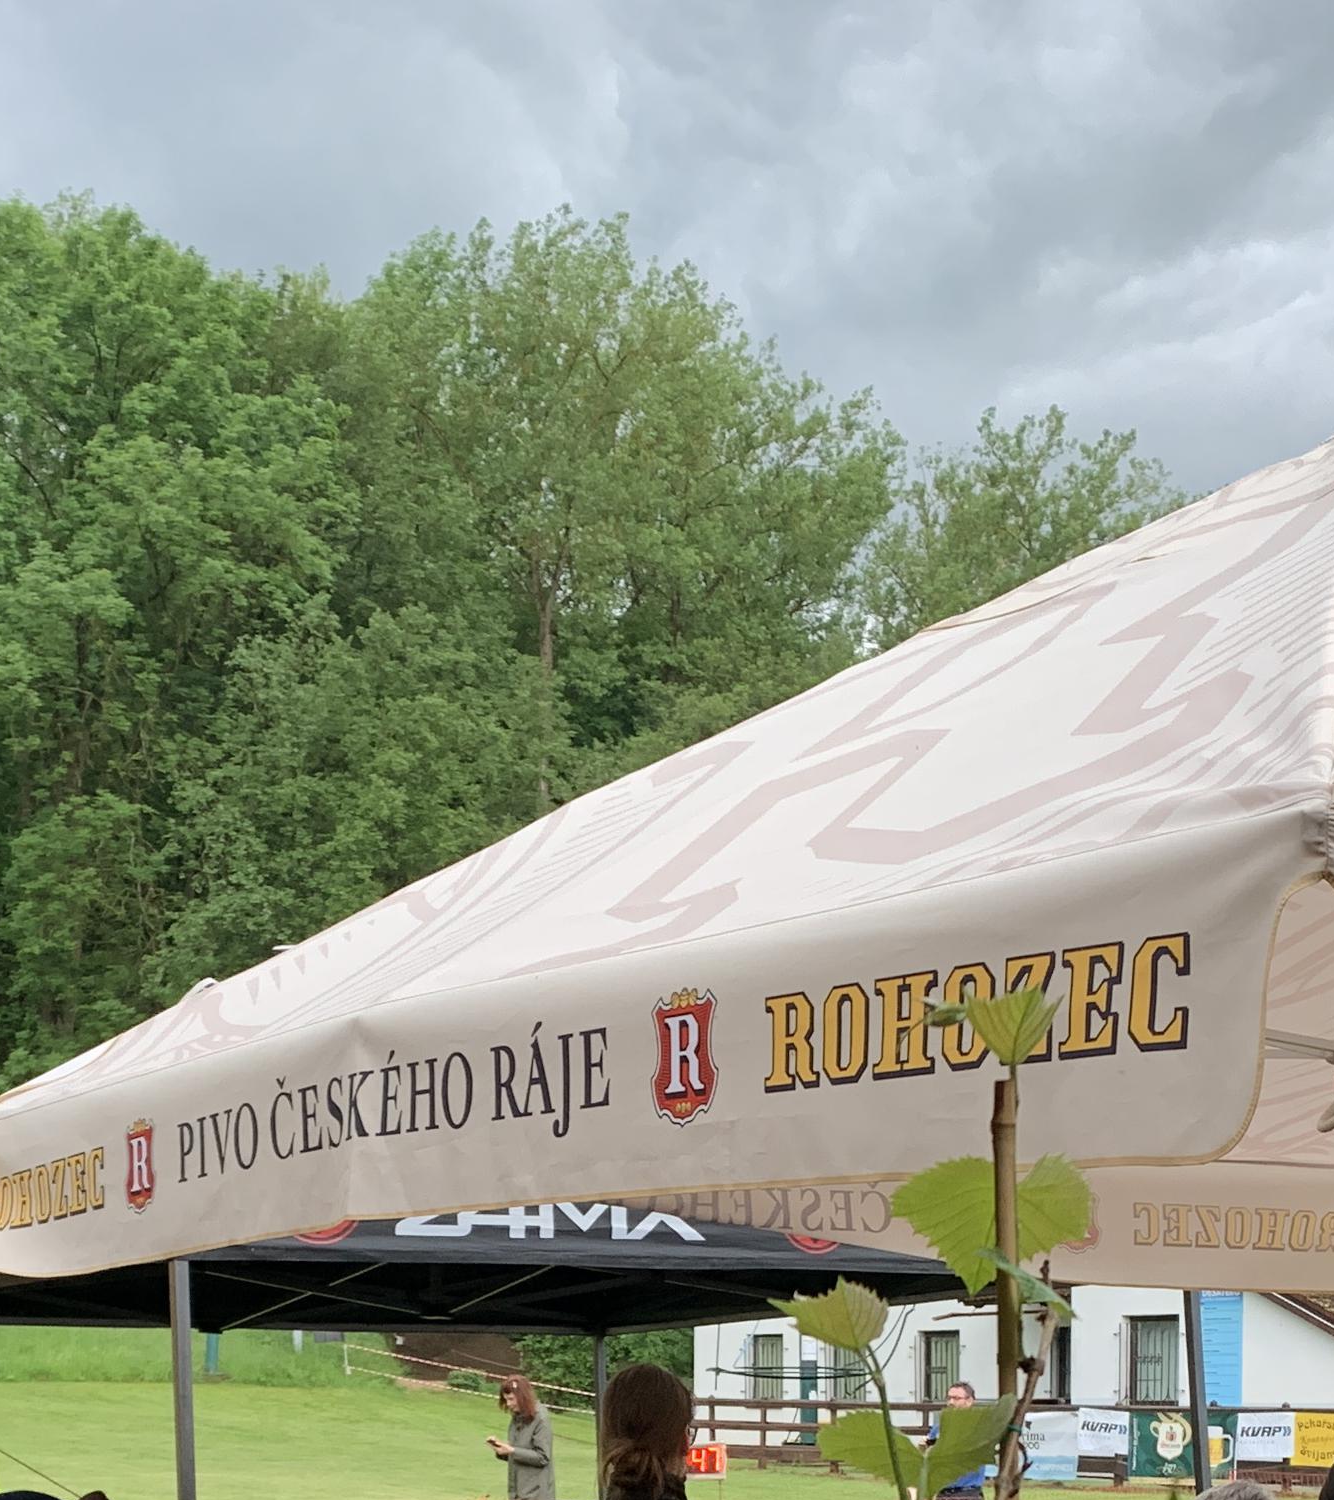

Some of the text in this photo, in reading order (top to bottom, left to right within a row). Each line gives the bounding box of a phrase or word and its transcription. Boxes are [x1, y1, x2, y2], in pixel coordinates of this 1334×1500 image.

[177, 1103, 258, 1183] PIVO
[270, 1050, 473, 1159] ČESKÉHO
[490, 1021, 610, 1138] RÁJE
[664, 1012, 706, 1098] R
[1081, 1420, 1118, 1434] KVAP
[1240, 1426, 1282, 1437] KVAP
[1021, 1431, 1046, 1441] rima
